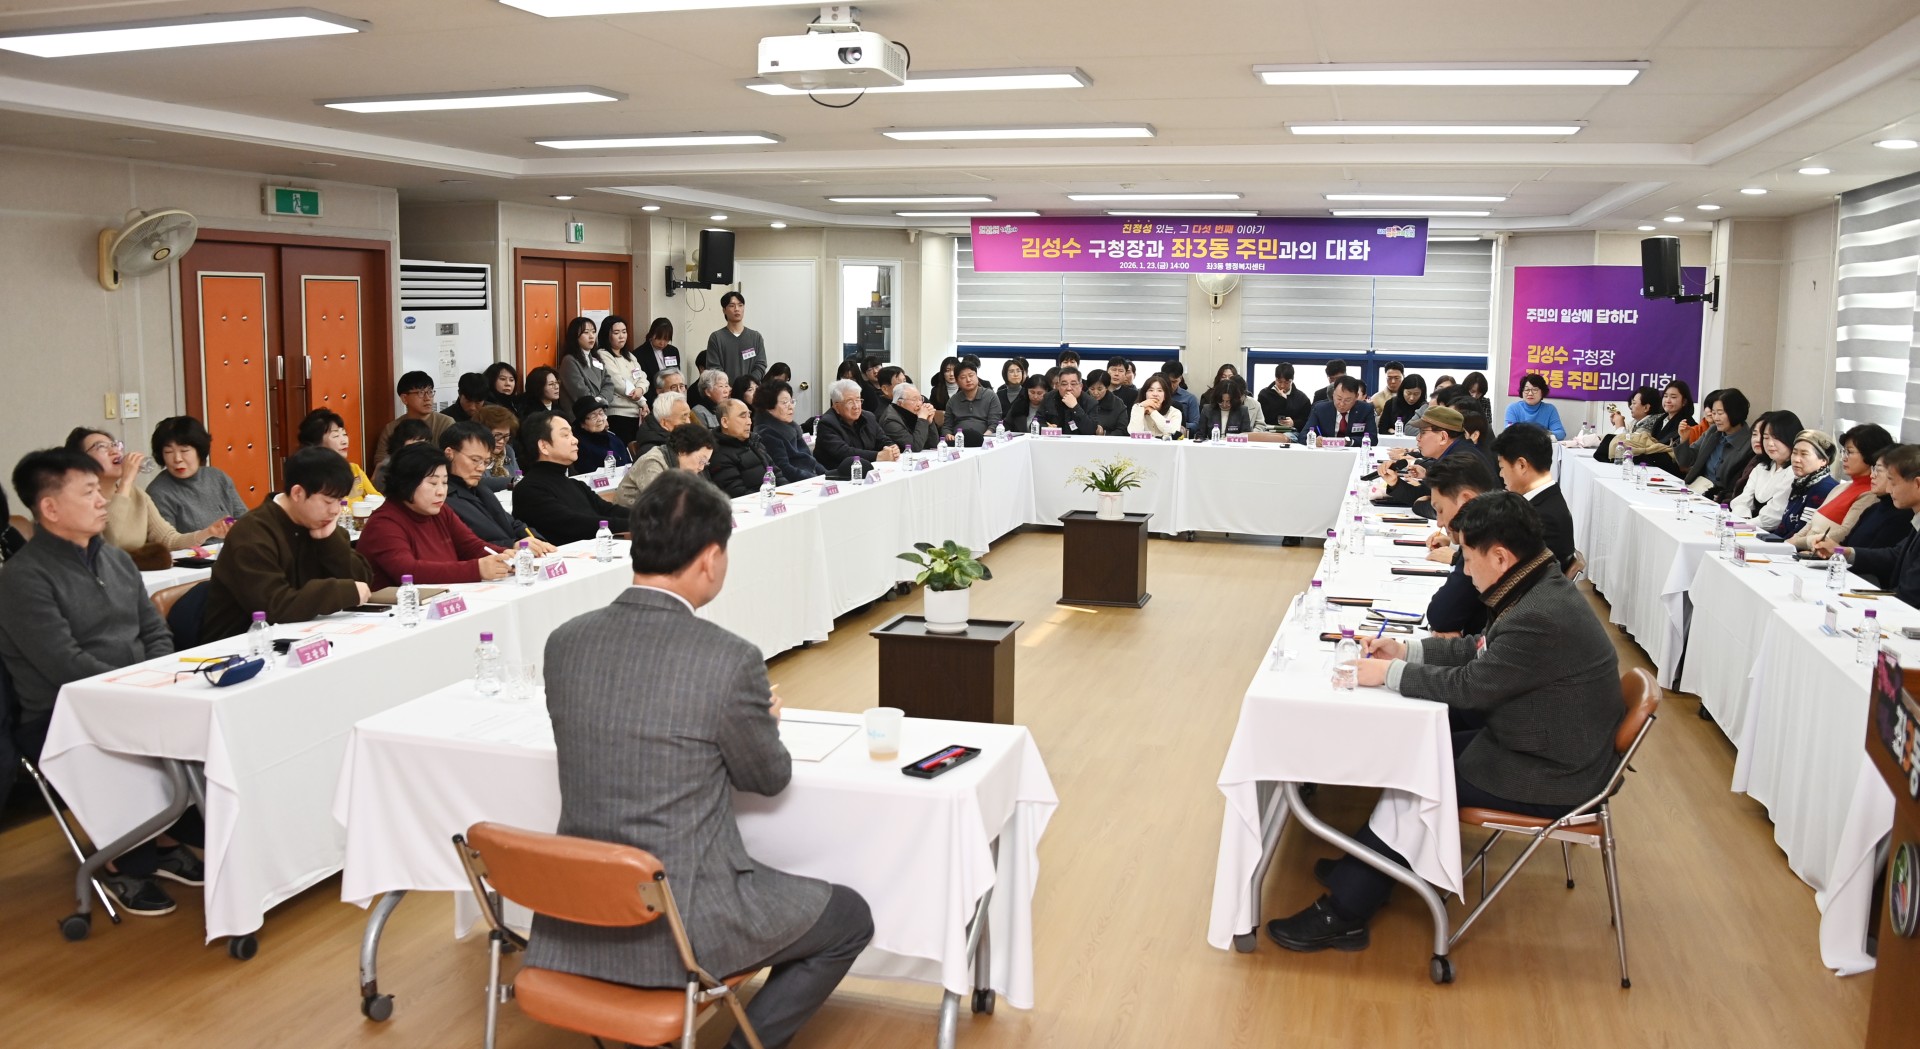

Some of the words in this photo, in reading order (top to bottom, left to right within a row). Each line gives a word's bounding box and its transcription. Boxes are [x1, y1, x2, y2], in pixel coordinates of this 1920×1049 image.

[1122, 223, 1153, 234] 진정성
[1155, 224, 1176, 235] 있는,
[1179, 225, 1189, 234] 그
[1192, 224, 1211, 234] 다섯
[1214, 224, 1233, 234] 번째
[1237, 225, 1265, 235] 이야기
[1021, 237, 1082, 259] 김성수
[1088, 239, 1164, 259] 구청장과
[1171, 238, 1230, 259] 좌3동
[1236, 238, 1317, 260] 주민과의
[1326, 239, 1370, 261] 대화
[1170, 262, 1190, 270] 14:00
[1206, 262, 1224, 271] 좌3동
[1225, 262, 1265, 271] 행정복지센터
[1526, 308, 1558, 323] 주민의
[1560, 308, 1593, 324] 일상에
[1596, 309, 1639, 325] 답하다
[1527, 345, 1569, 365] 김성수
[1572, 349, 1616, 366] 구청장
[1567, 370, 1635, 391] 주민과의
